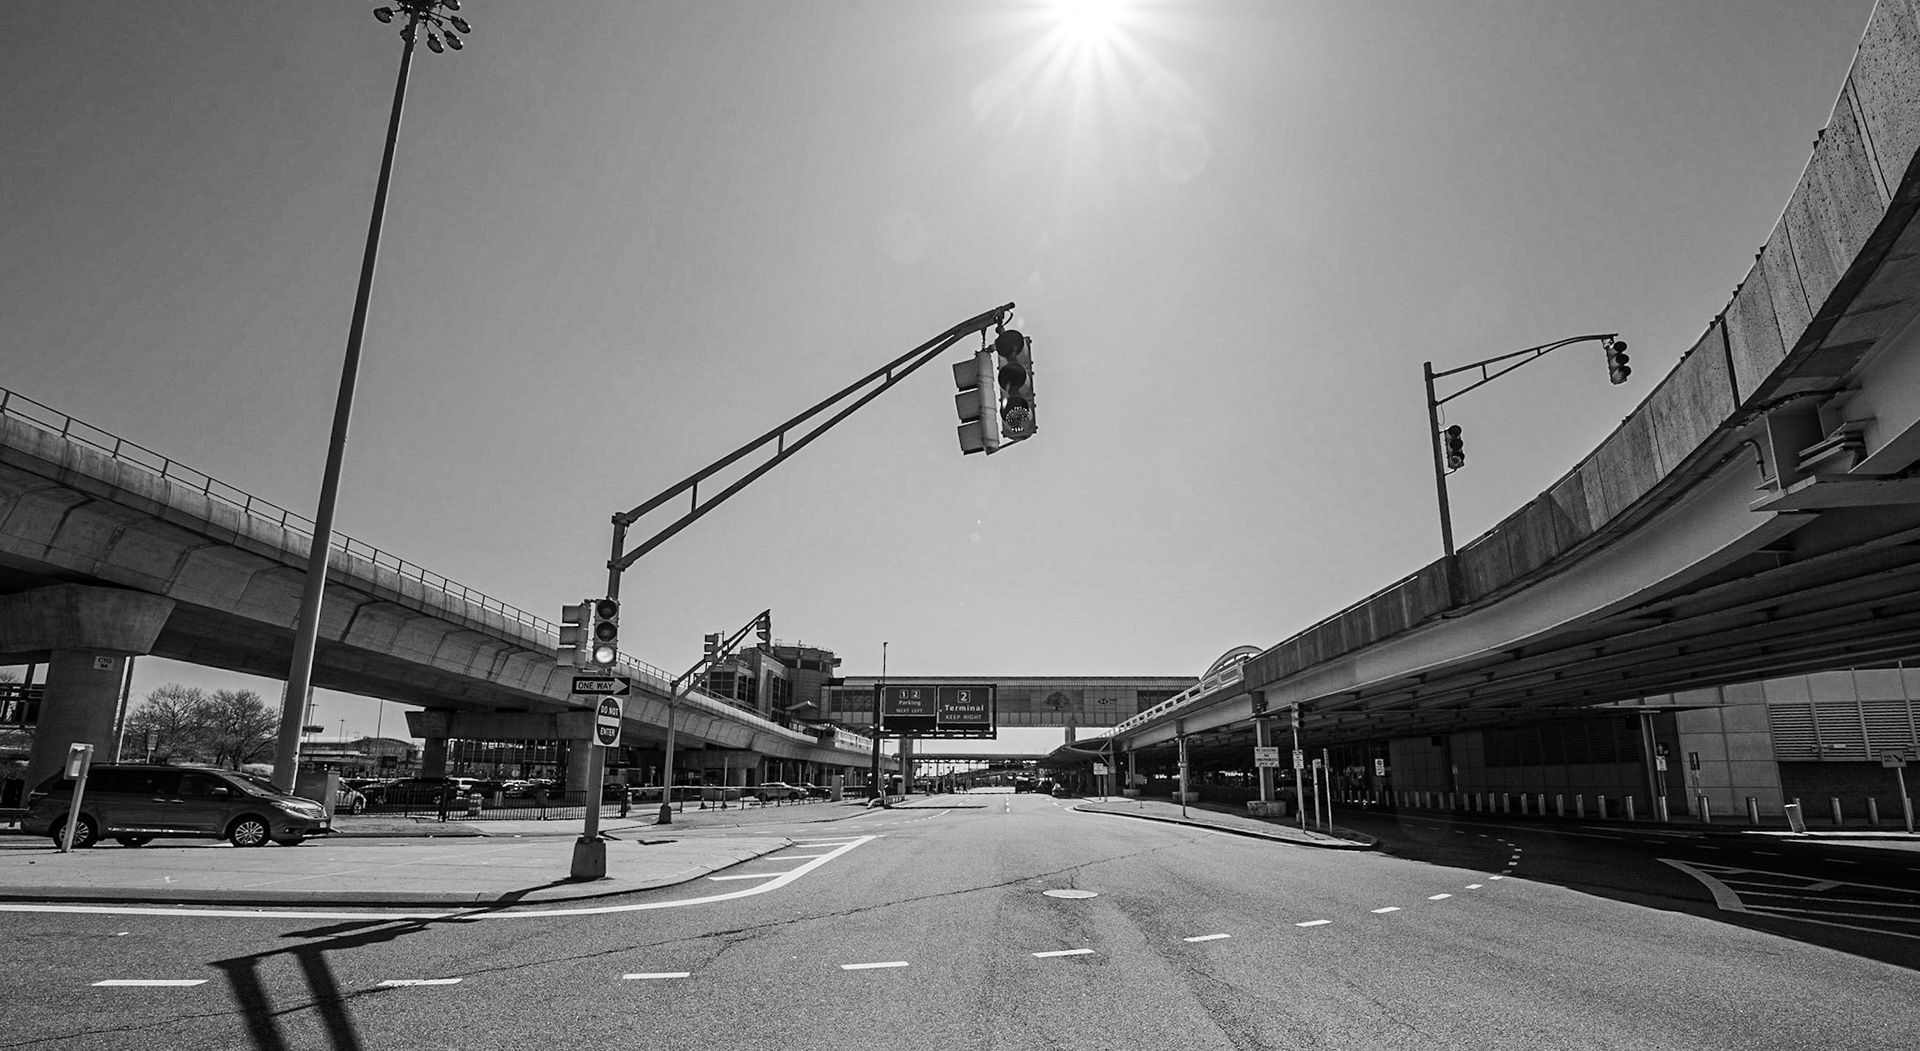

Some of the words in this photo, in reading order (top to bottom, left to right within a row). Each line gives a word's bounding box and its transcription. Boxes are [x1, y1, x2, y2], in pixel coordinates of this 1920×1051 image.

[960, 692, 968, 702] 2
[600, 705, 608, 714] DO
[609, 707, 618, 716] NOT
[944, 704, 984, 712] Terminal
[600, 727, 615, 737] ENTER
